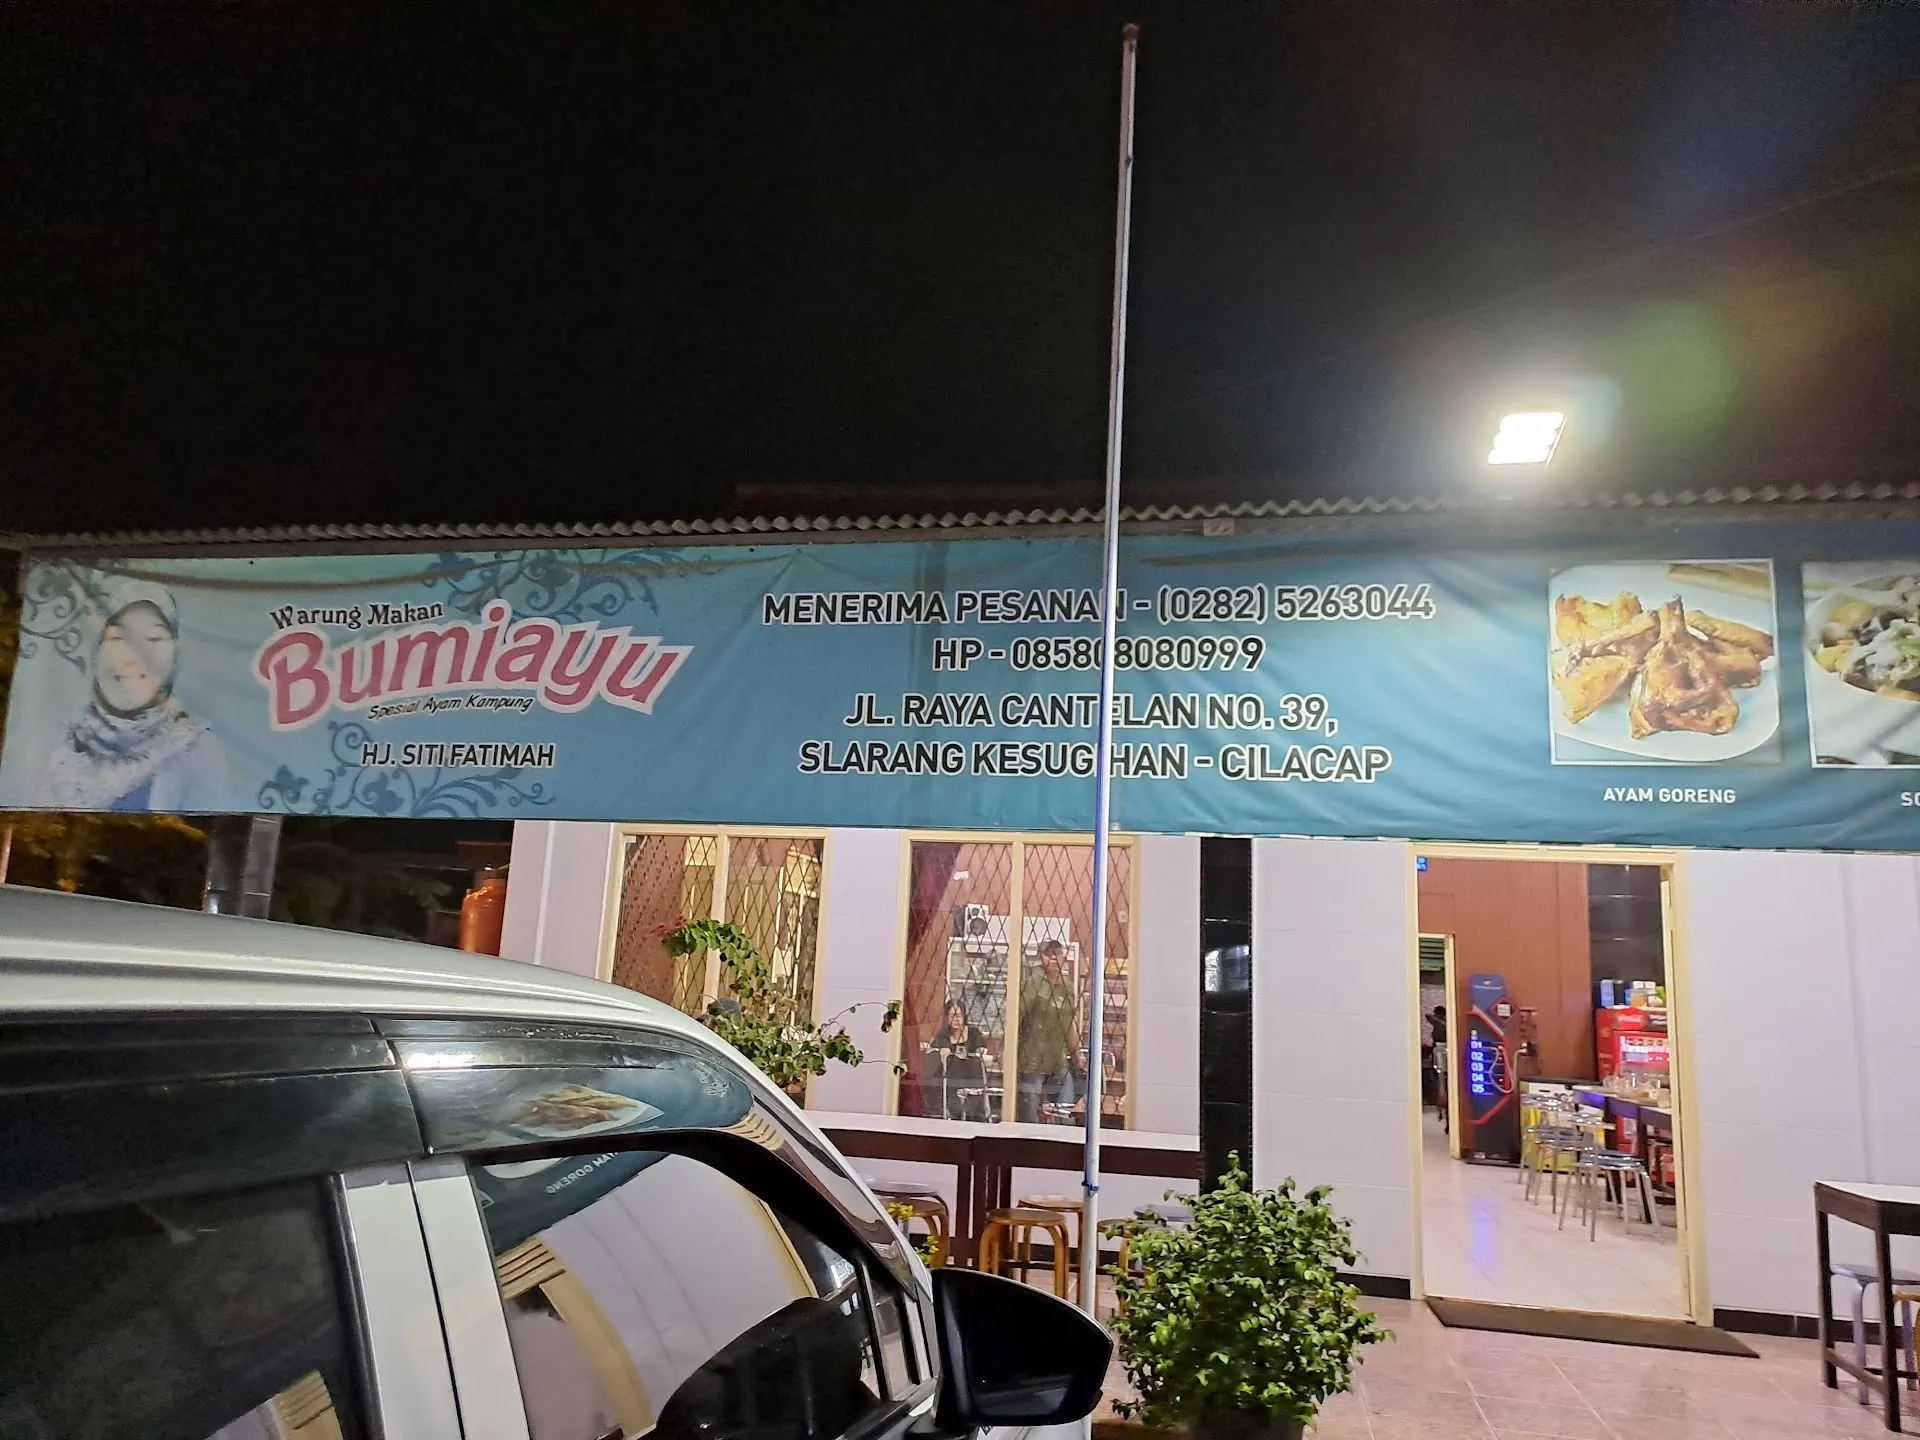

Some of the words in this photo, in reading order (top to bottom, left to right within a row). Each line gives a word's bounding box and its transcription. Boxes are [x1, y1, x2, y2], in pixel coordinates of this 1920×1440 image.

[270, 605, 361, 630] Warung
[368, 602, 443, 625] Makan
[765, 593, 948, 625] MENERIMA
[1158, 584, 1267, 624] (0282)
[1276, 584, 1436, 620] 5263044
[258, 606, 685, 725] Bumiayu
[933, 638, 982, 671] HP
[367, 702, 420, 720] Spesial
[423, 696, 463, 714] Ayam
[465, 694, 534, 713] Kampung
[844, 695, 895, 728] JL.
[903, 694, 992, 727] RAYA
[1207, 697, 1274, 730] NO.
[1280, 695, 1339, 737] 39,
[361, 742, 395, 766] HJ.
[402, 743, 445, 766] SITI
[450, 743, 556, 767] FATIMAH
[798, 740, 964, 775] SLARANG
[972, 742, 1188, 779] KESUGHAN
[1220, 745, 1393, 782] CILACAP
[1602, 787, 1654, 802] AYAM
[1658, 788, 1737, 804] GORENG
